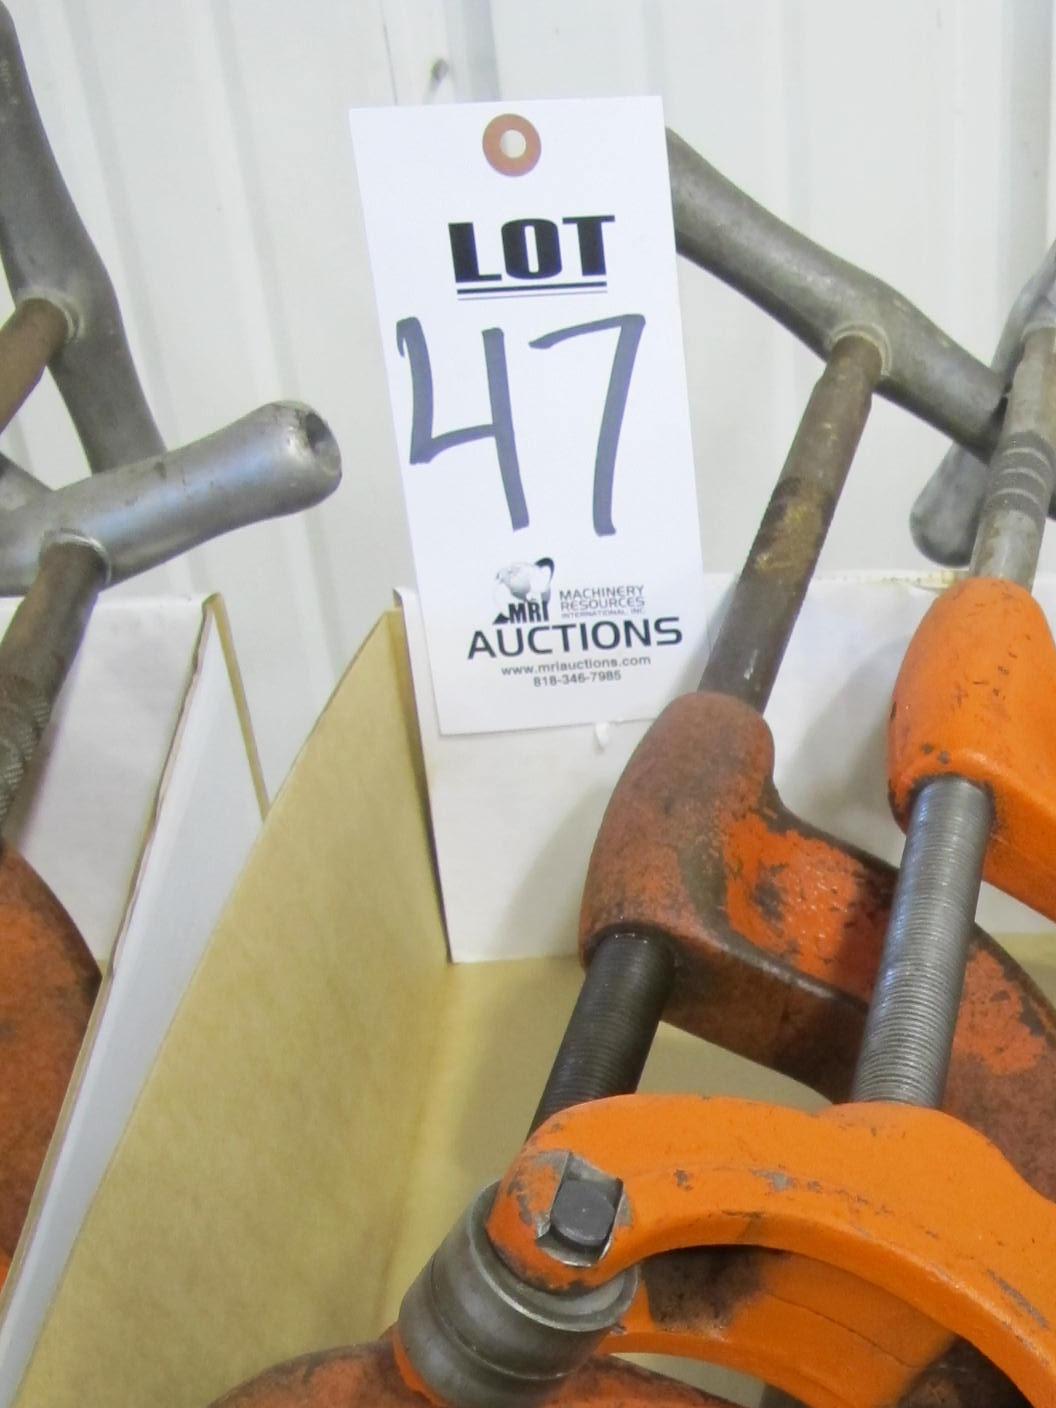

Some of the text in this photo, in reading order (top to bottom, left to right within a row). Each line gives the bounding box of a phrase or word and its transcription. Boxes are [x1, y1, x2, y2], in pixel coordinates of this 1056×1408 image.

[448, 215, 616, 284] LOT
[396, 313, 646, 537] 47
[559, 585, 645, 601] MACHINERY
[560, 597, 645, 612] RESOURCES
[507, 600, 549, 625] MRI
[467, 616, 682, 660] AUCTIONS
[533, 670, 622, 687] 818-346-7985
